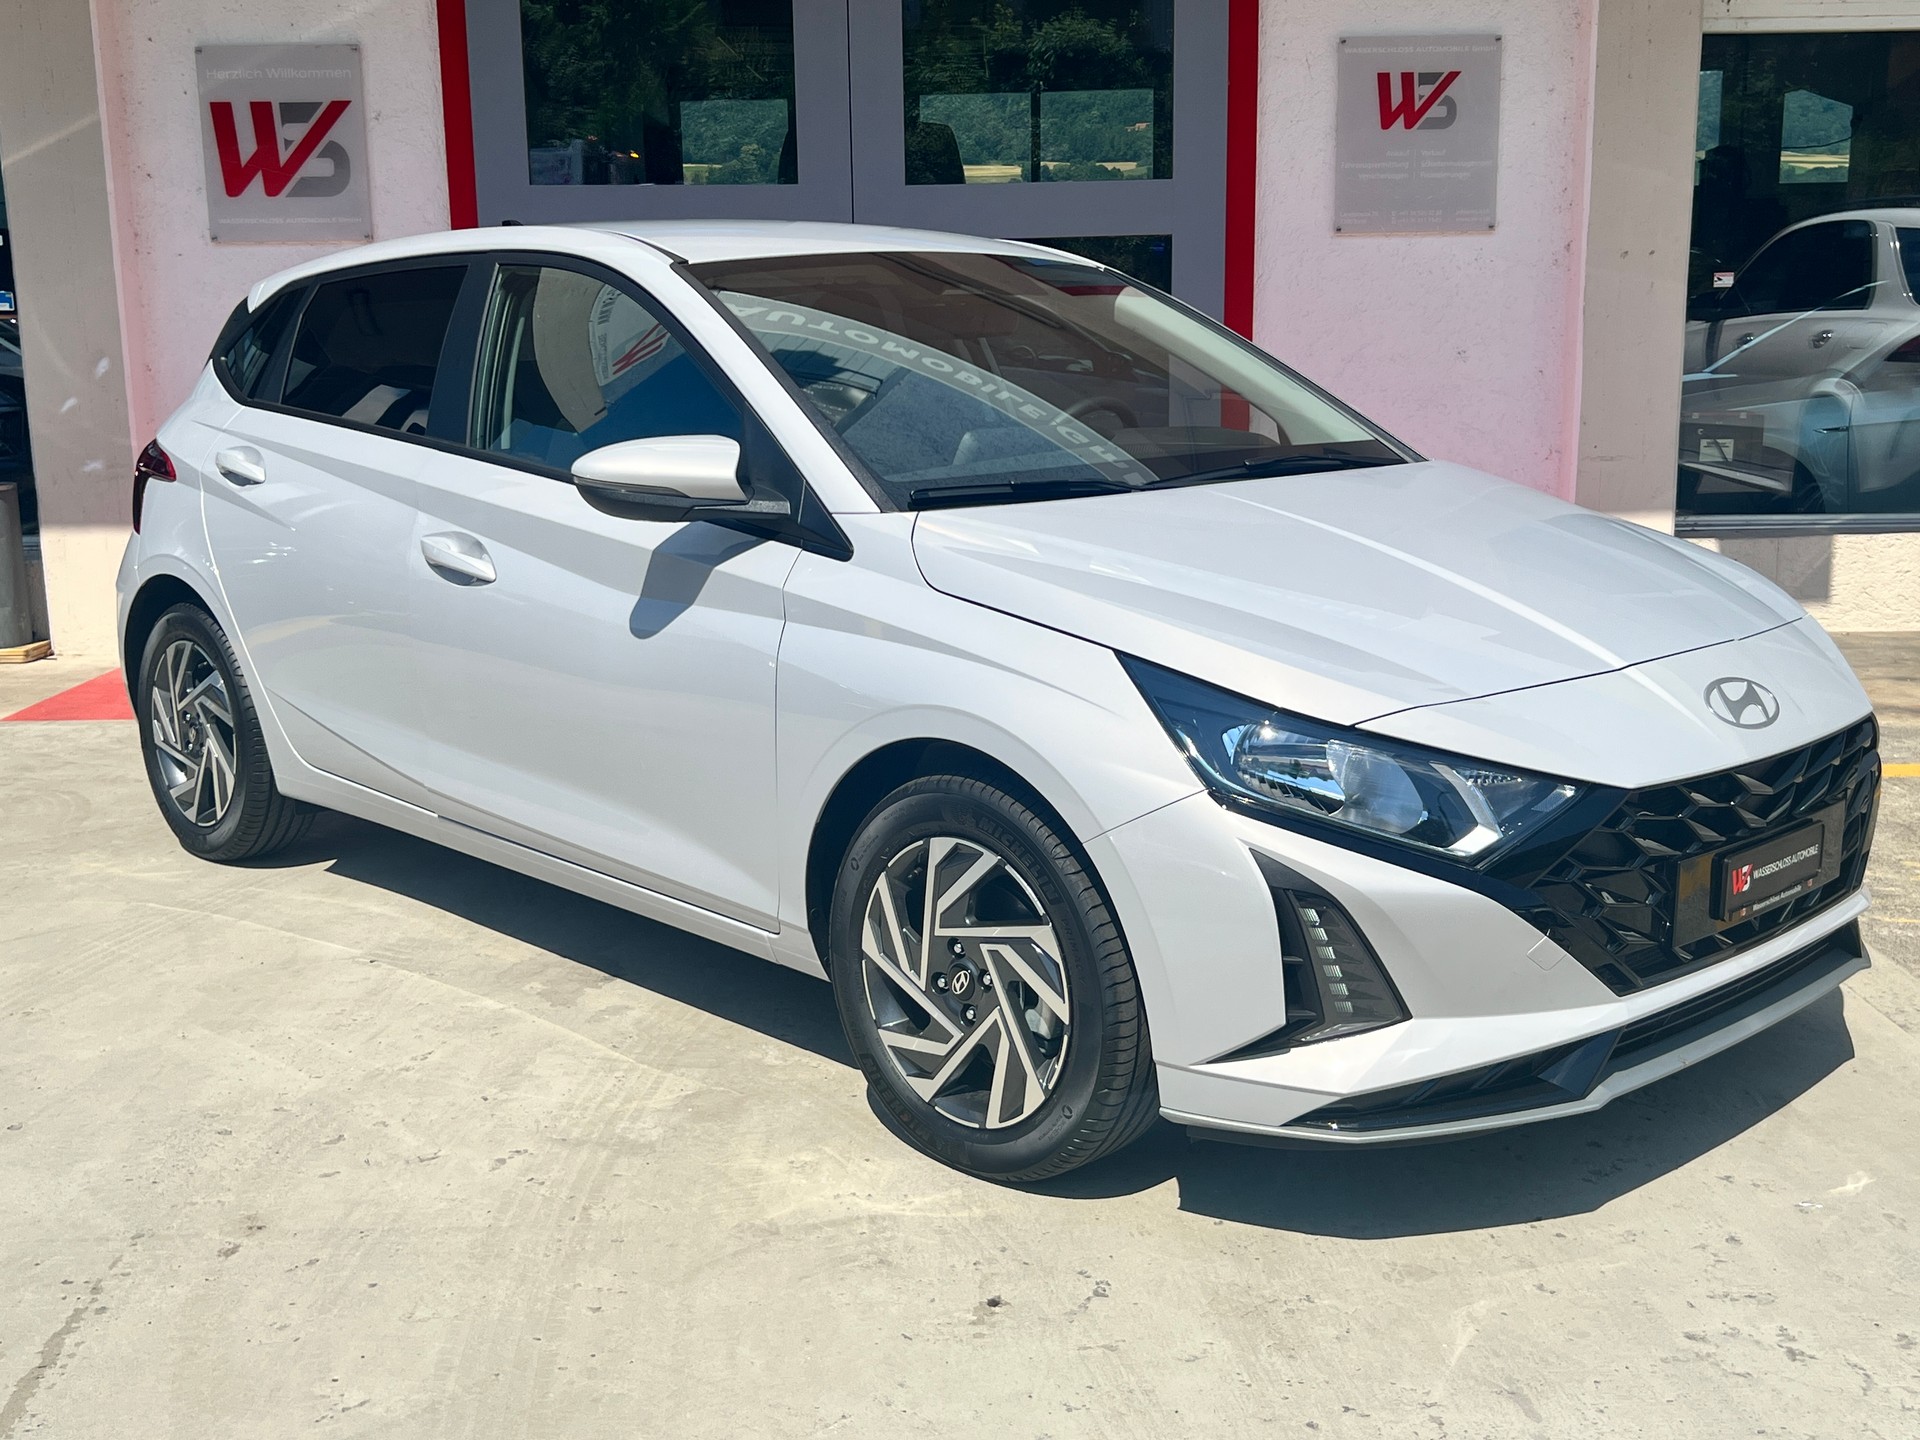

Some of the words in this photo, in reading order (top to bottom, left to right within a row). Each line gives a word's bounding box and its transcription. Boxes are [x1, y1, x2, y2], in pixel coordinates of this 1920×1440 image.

[206, 68, 262, 80] Herzlich
[267, 67, 351, 79] Willkommen
[978, 816, 1058, 904] MICHELIN
